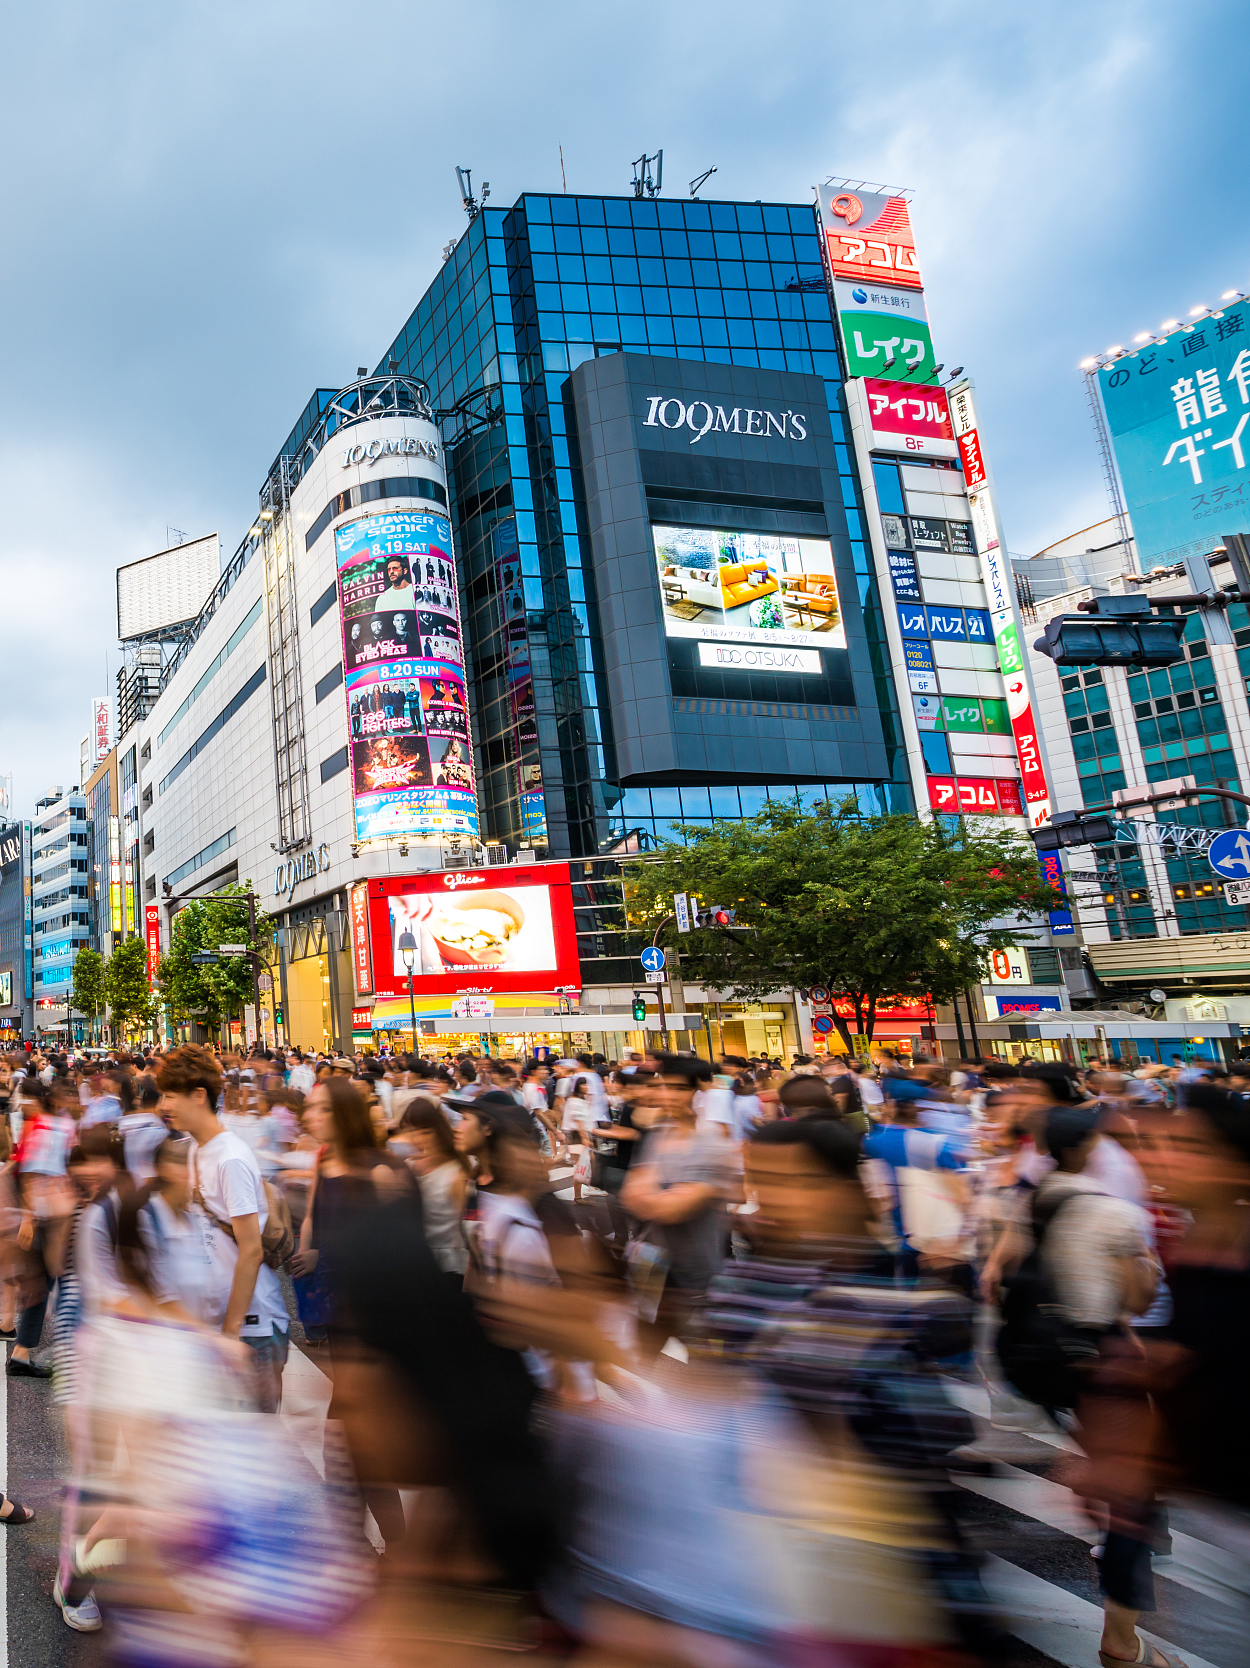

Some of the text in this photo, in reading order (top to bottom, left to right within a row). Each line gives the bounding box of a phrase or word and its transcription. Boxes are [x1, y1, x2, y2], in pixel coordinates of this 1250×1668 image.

[839, 237, 919, 272] アコム
[870, 293, 910, 308] 新生銀行
[853, 331, 925, 364] レイク
[1108, 314, 1245, 388] のど、直接
[869, 394, 947, 423] アイフル
[905, 437, 924, 450] 8F
[964, 444, 982, 484] アイフル
[1191, 481, 1250, 511] スティ
[357, 515, 435, 532] SUMMER
[367, 524, 428, 538] SONIC
[371, 541, 428, 556] 8.19 SAT
[343, 571, 385, 591] CALVIN
[344, 584, 386, 603] HARRIS
[901, 613, 986, 636] レオパレス21
[355, 644, 408, 664] EYED PEAS
[362, 638, 396, 653] BLACK
[906, 651, 923, 659] 0120
[1000, 634, 1018, 668] レイク
[744, 650, 805, 668] OTSUKA
[908, 660, 932, 668] 008021
[380, 664, 440, 679] 8.20 SUN
[918, 681, 929, 690] 6F
[360, 709, 386, 723] FOO
[943, 706, 980, 723] レイク
[96, 701, 109, 750] 大和証券
[361, 716, 412, 735] FIGHTERS
[1018, 735, 1039, 773] アコム
[935, 784, 996, 805] アコム
[443, 873, 486, 890] Glico
[355, 905, 370, 990] 天津甘栗
